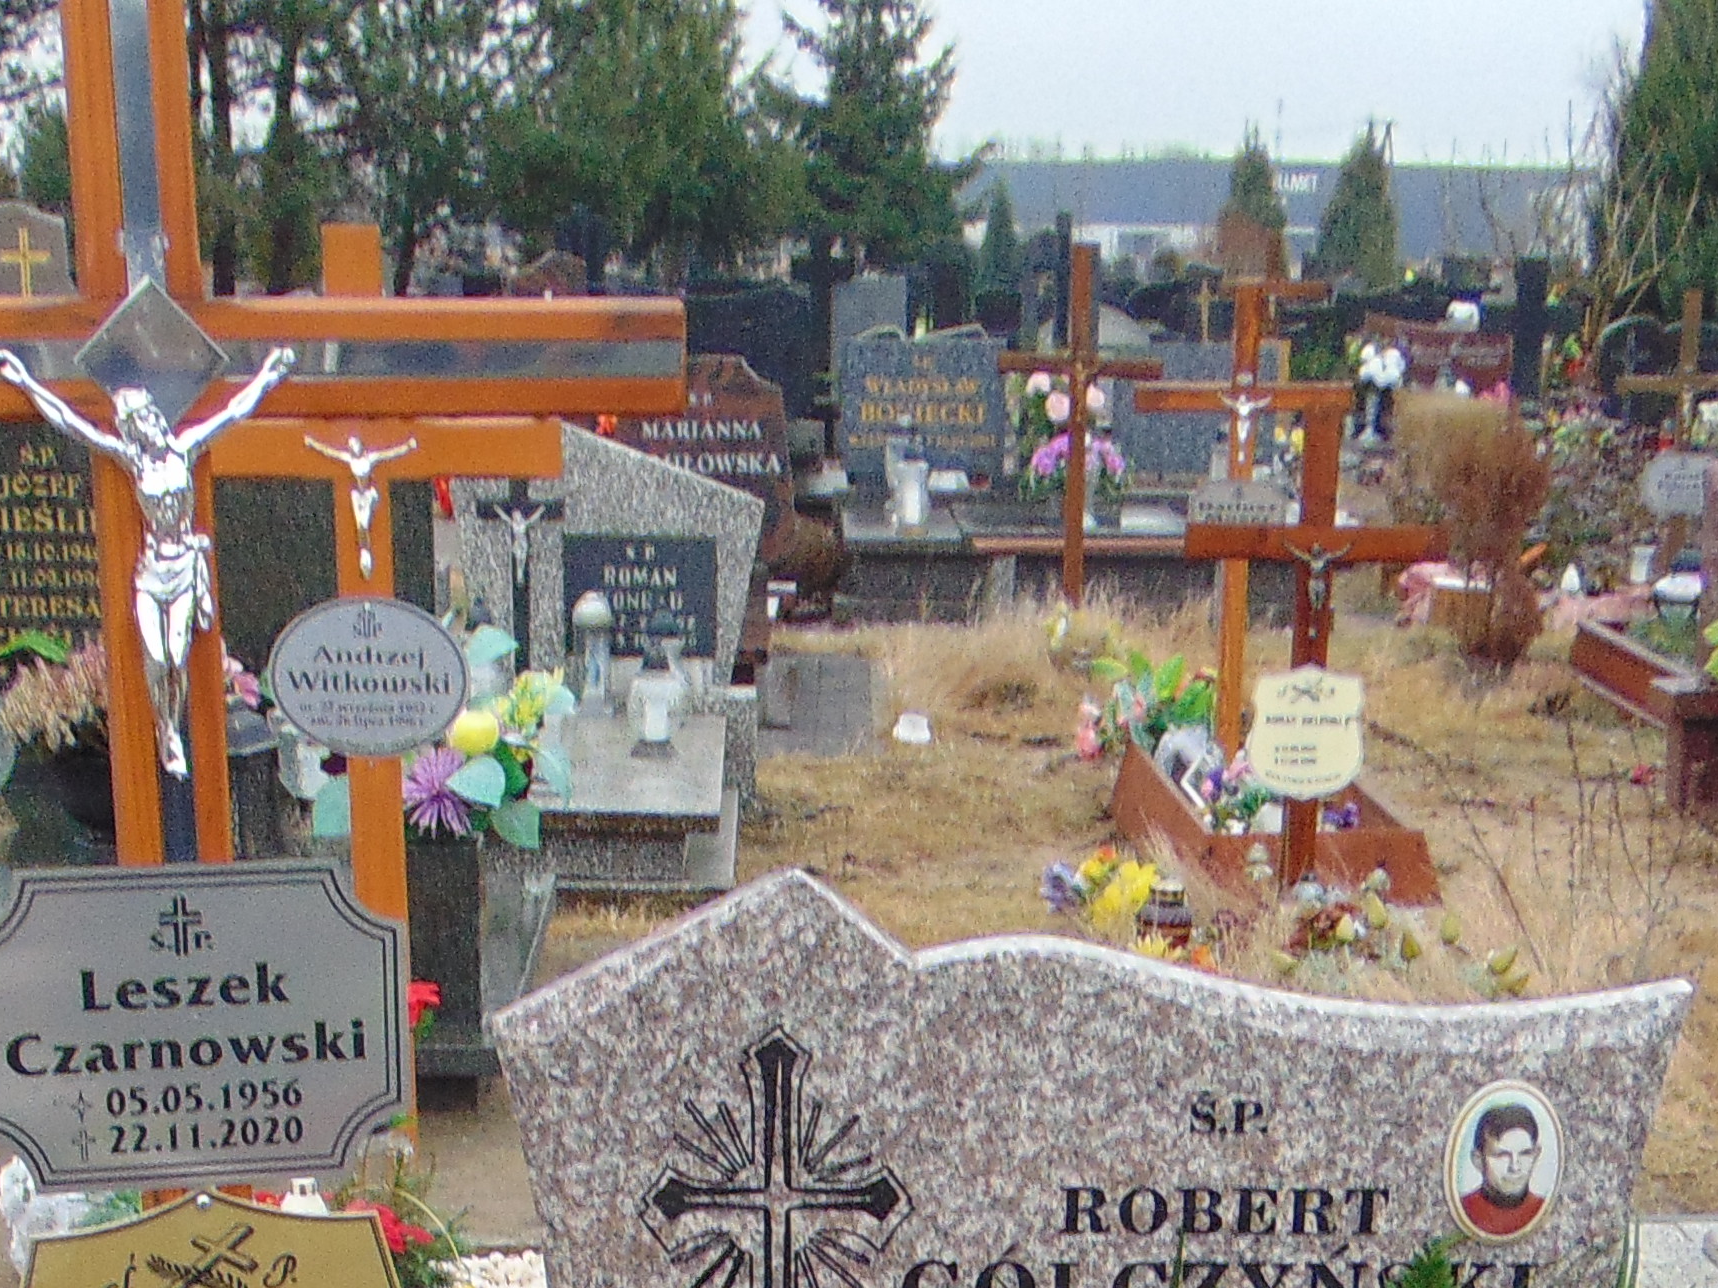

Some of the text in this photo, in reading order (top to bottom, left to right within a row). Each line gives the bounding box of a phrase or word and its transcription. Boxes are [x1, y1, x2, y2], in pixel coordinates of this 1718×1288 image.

[641, 420, 763, 440] MARIANNA
[603, 566, 678, 587] ROMAN
[314, 644, 426, 672] Andrzej
[287, 666, 453, 695] Witkowski
[80, 961, 290, 1012] Leszek
[5, 1017, 367, 1076] Czarnowski
[106, 1078, 304, 1117] 05.05.1956
[109, 1115, 305, 1154] 22.11.2020
[1059, 1184, 1392, 1236] ROBERT
